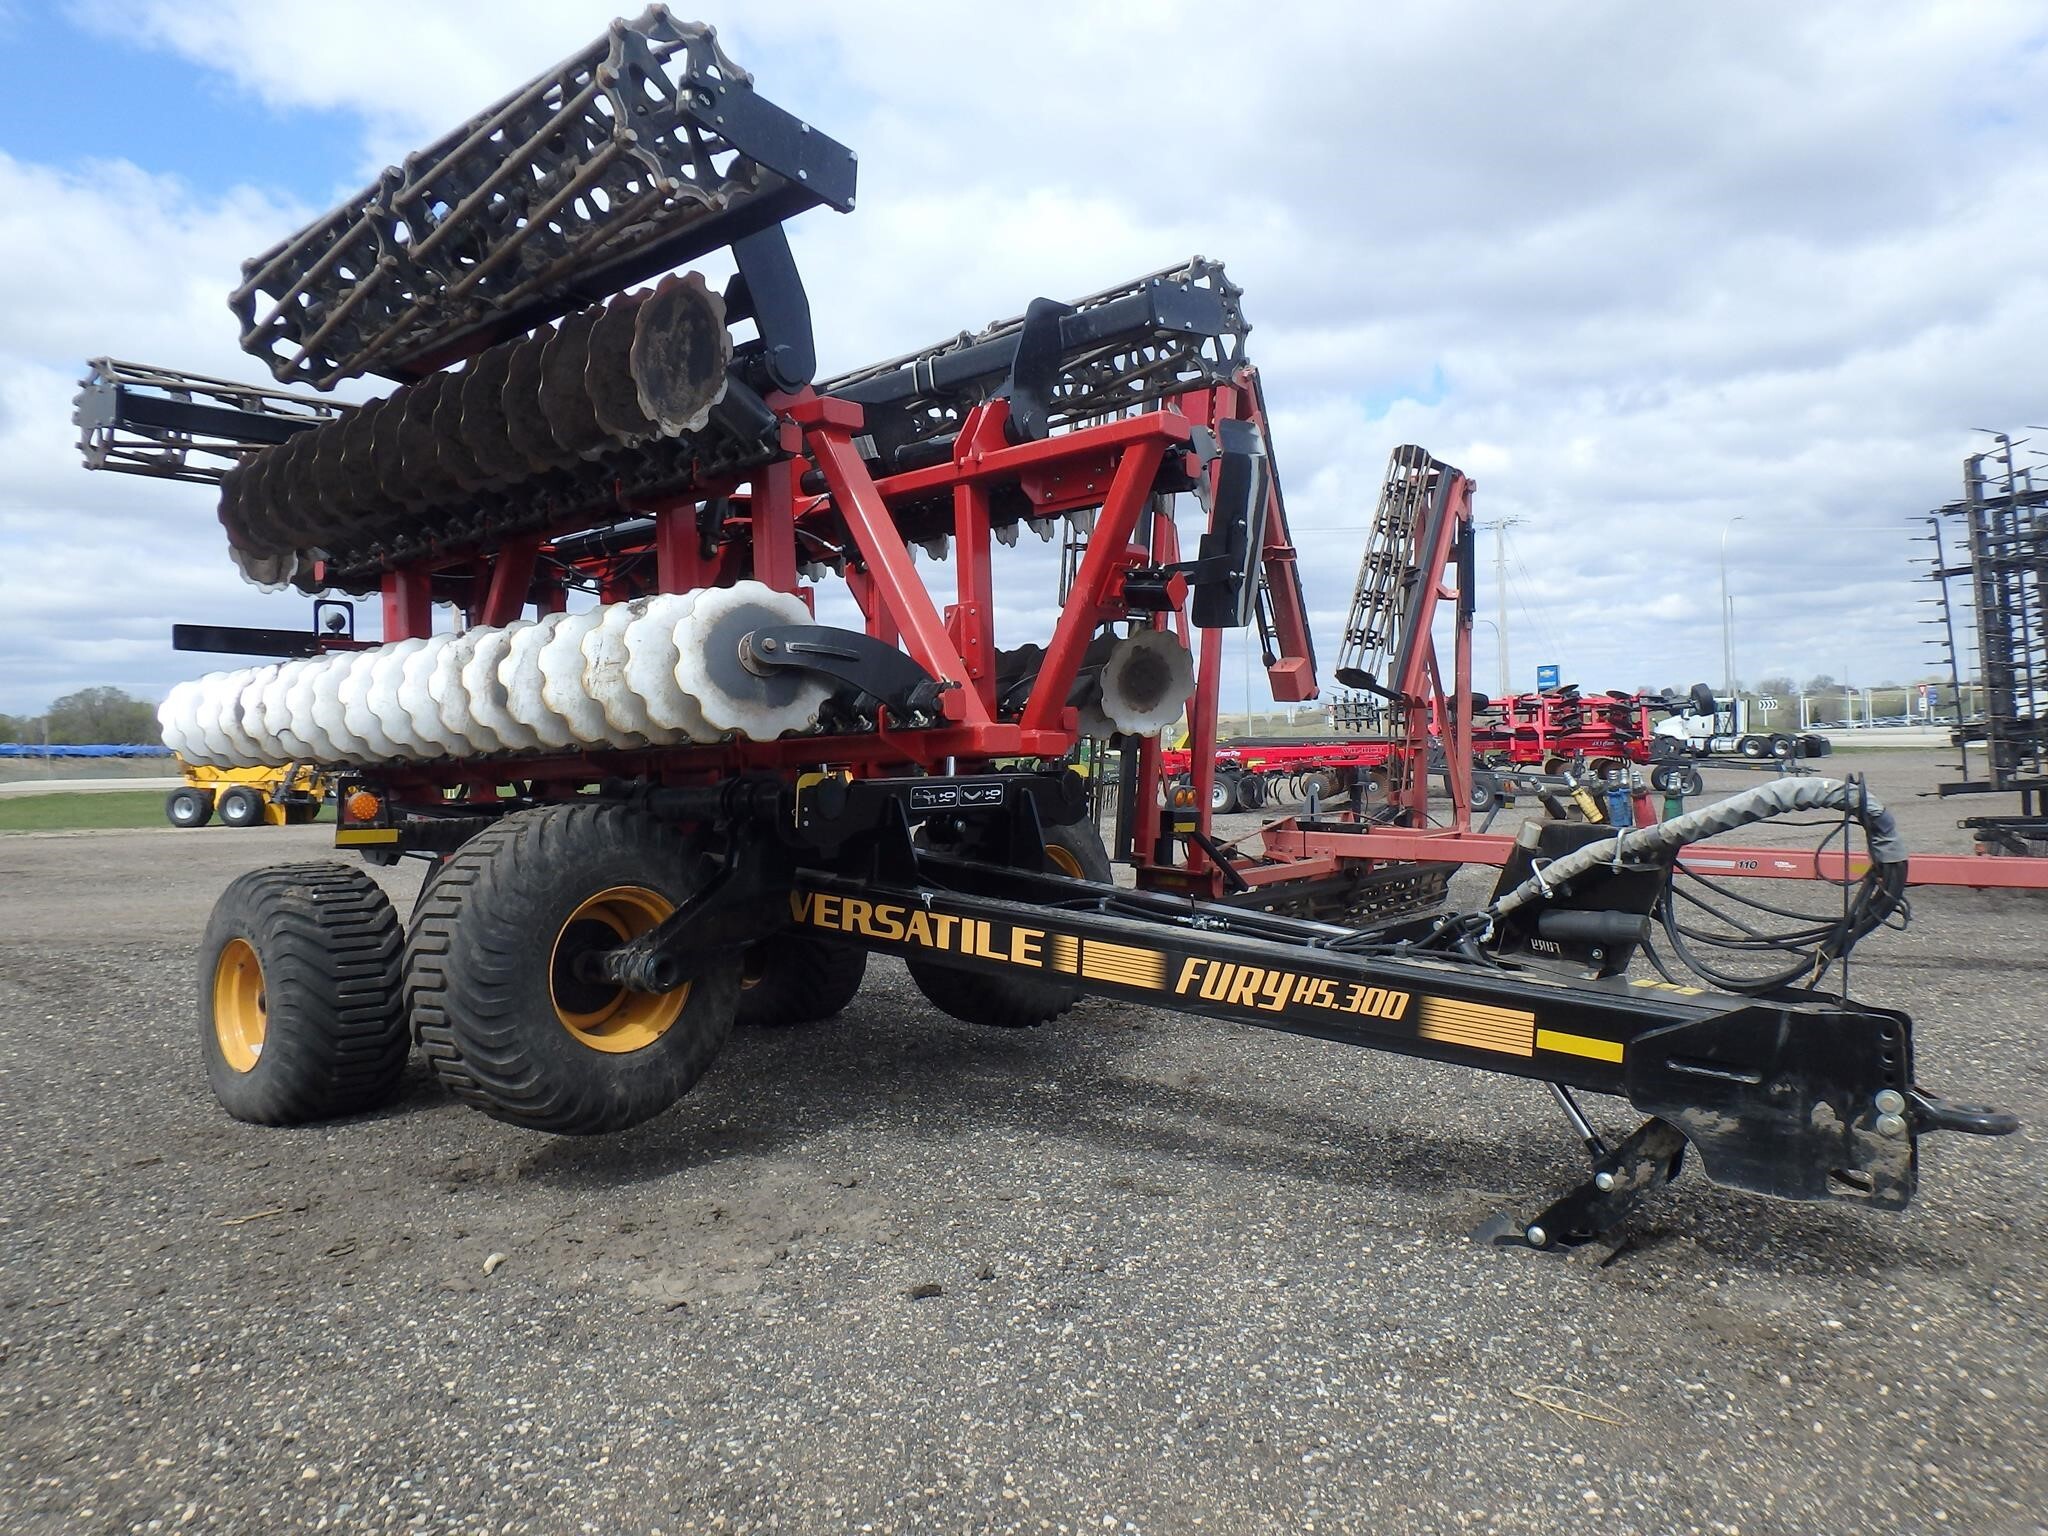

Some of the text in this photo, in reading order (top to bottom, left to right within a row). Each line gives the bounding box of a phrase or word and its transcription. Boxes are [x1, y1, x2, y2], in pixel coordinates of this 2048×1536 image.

[1738, 860, 1759, 870] 110
[789, 889, 1046, 968] VERSATILE
[1174, 957, 1296, 1012] FURY
